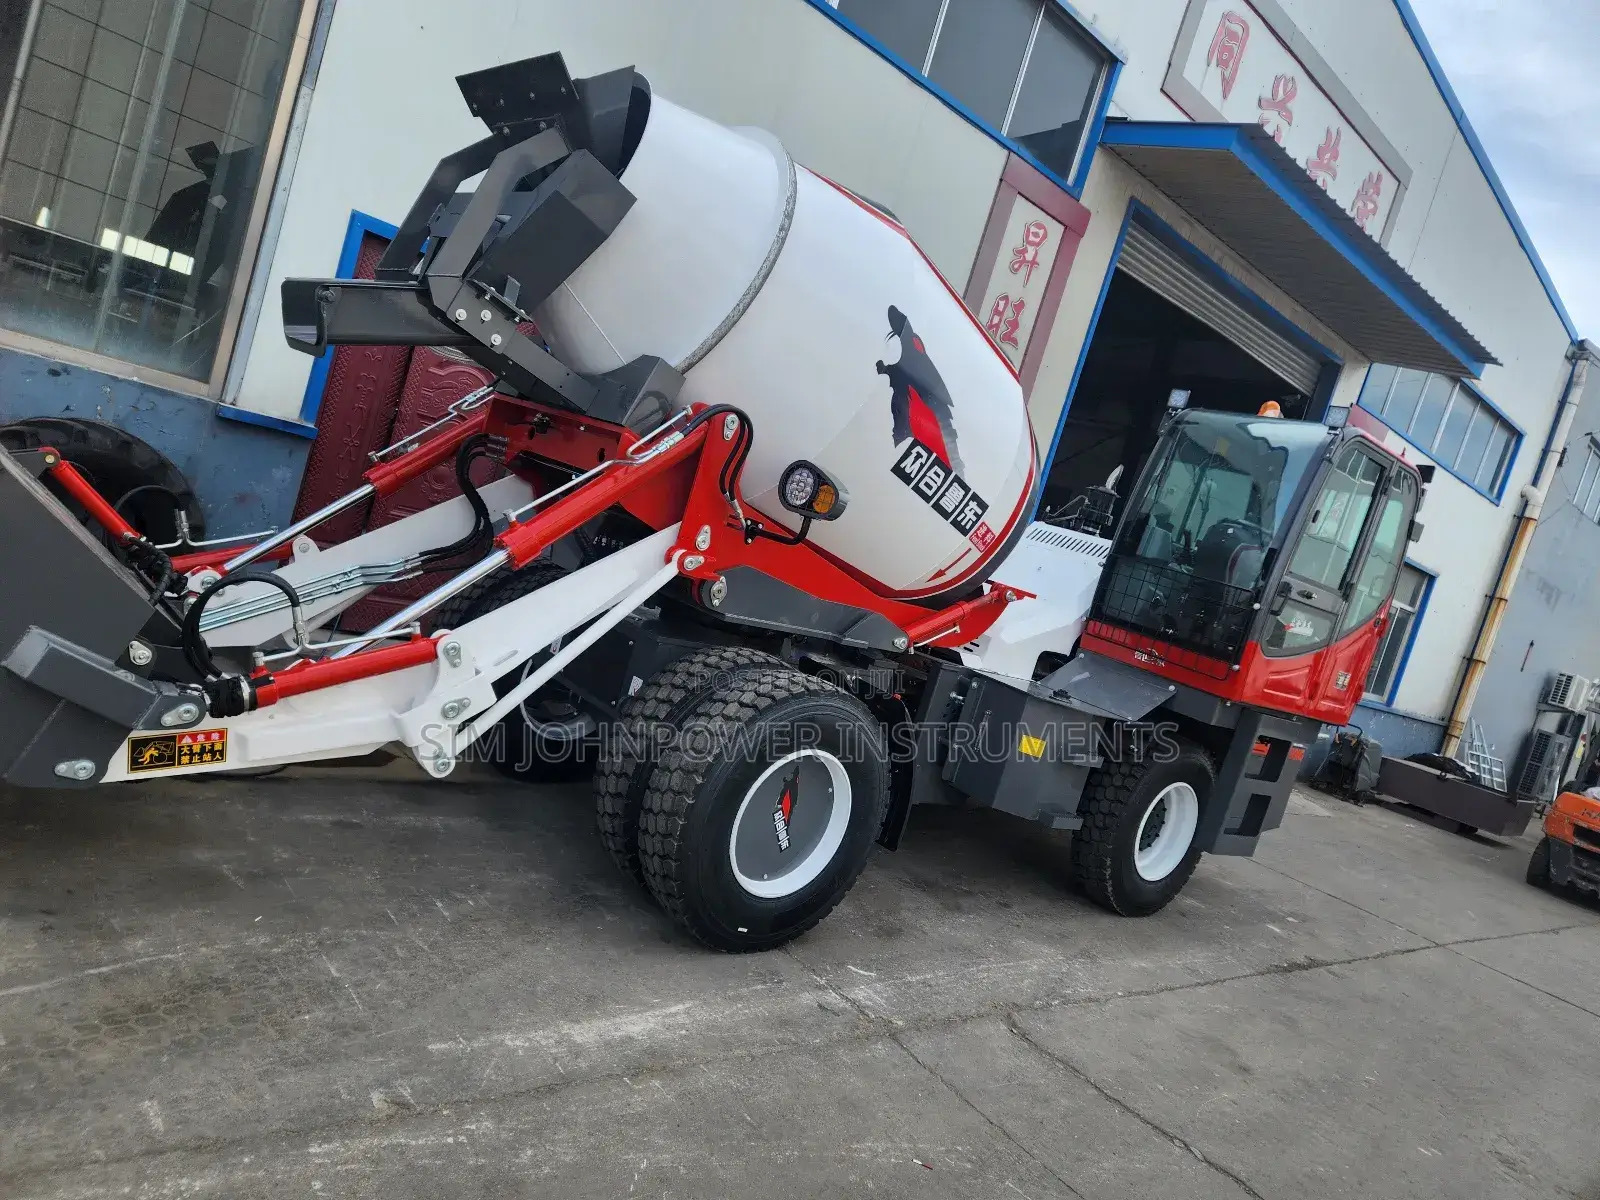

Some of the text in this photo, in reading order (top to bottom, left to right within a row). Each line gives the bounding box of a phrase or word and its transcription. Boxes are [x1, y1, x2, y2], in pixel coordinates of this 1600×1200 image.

[898, 443, 985, 532] 众合鲁东
[180, 741, 223, 754] 大臂下面
[180, 751, 222, 764] 禁止站人
